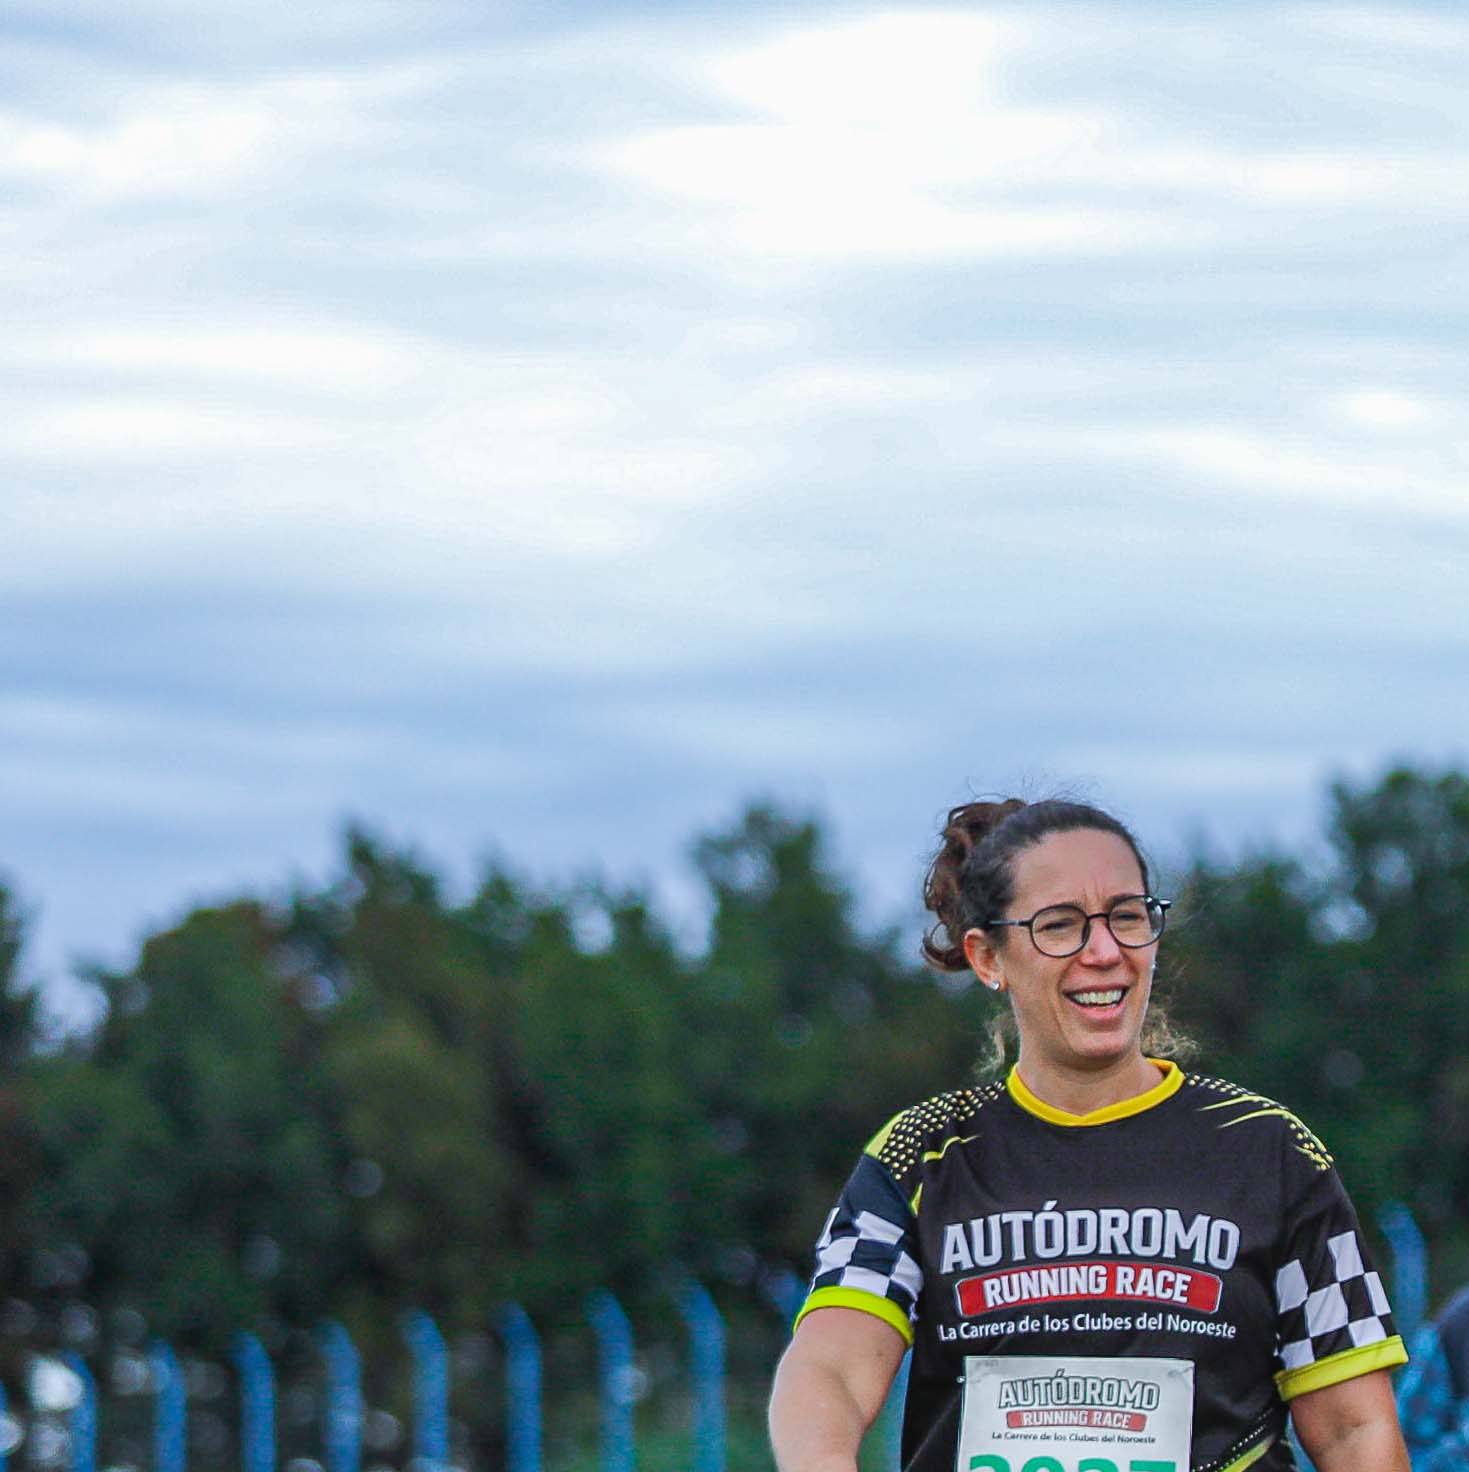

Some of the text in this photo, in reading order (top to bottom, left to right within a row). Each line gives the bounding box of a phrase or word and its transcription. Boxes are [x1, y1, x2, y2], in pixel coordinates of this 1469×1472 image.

[939, 1200, 1241, 1275] AUTÓDROMO
[983, 1265, 1192, 1308] RUNNING RACE
[940, 1312, 1237, 1342] La Carrera de los Clubes del Noroeste
[998, 1368, 1160, 1411] AUTÓDROMO
[1022, 1410, 1131, 1429] RUNNING RACE
